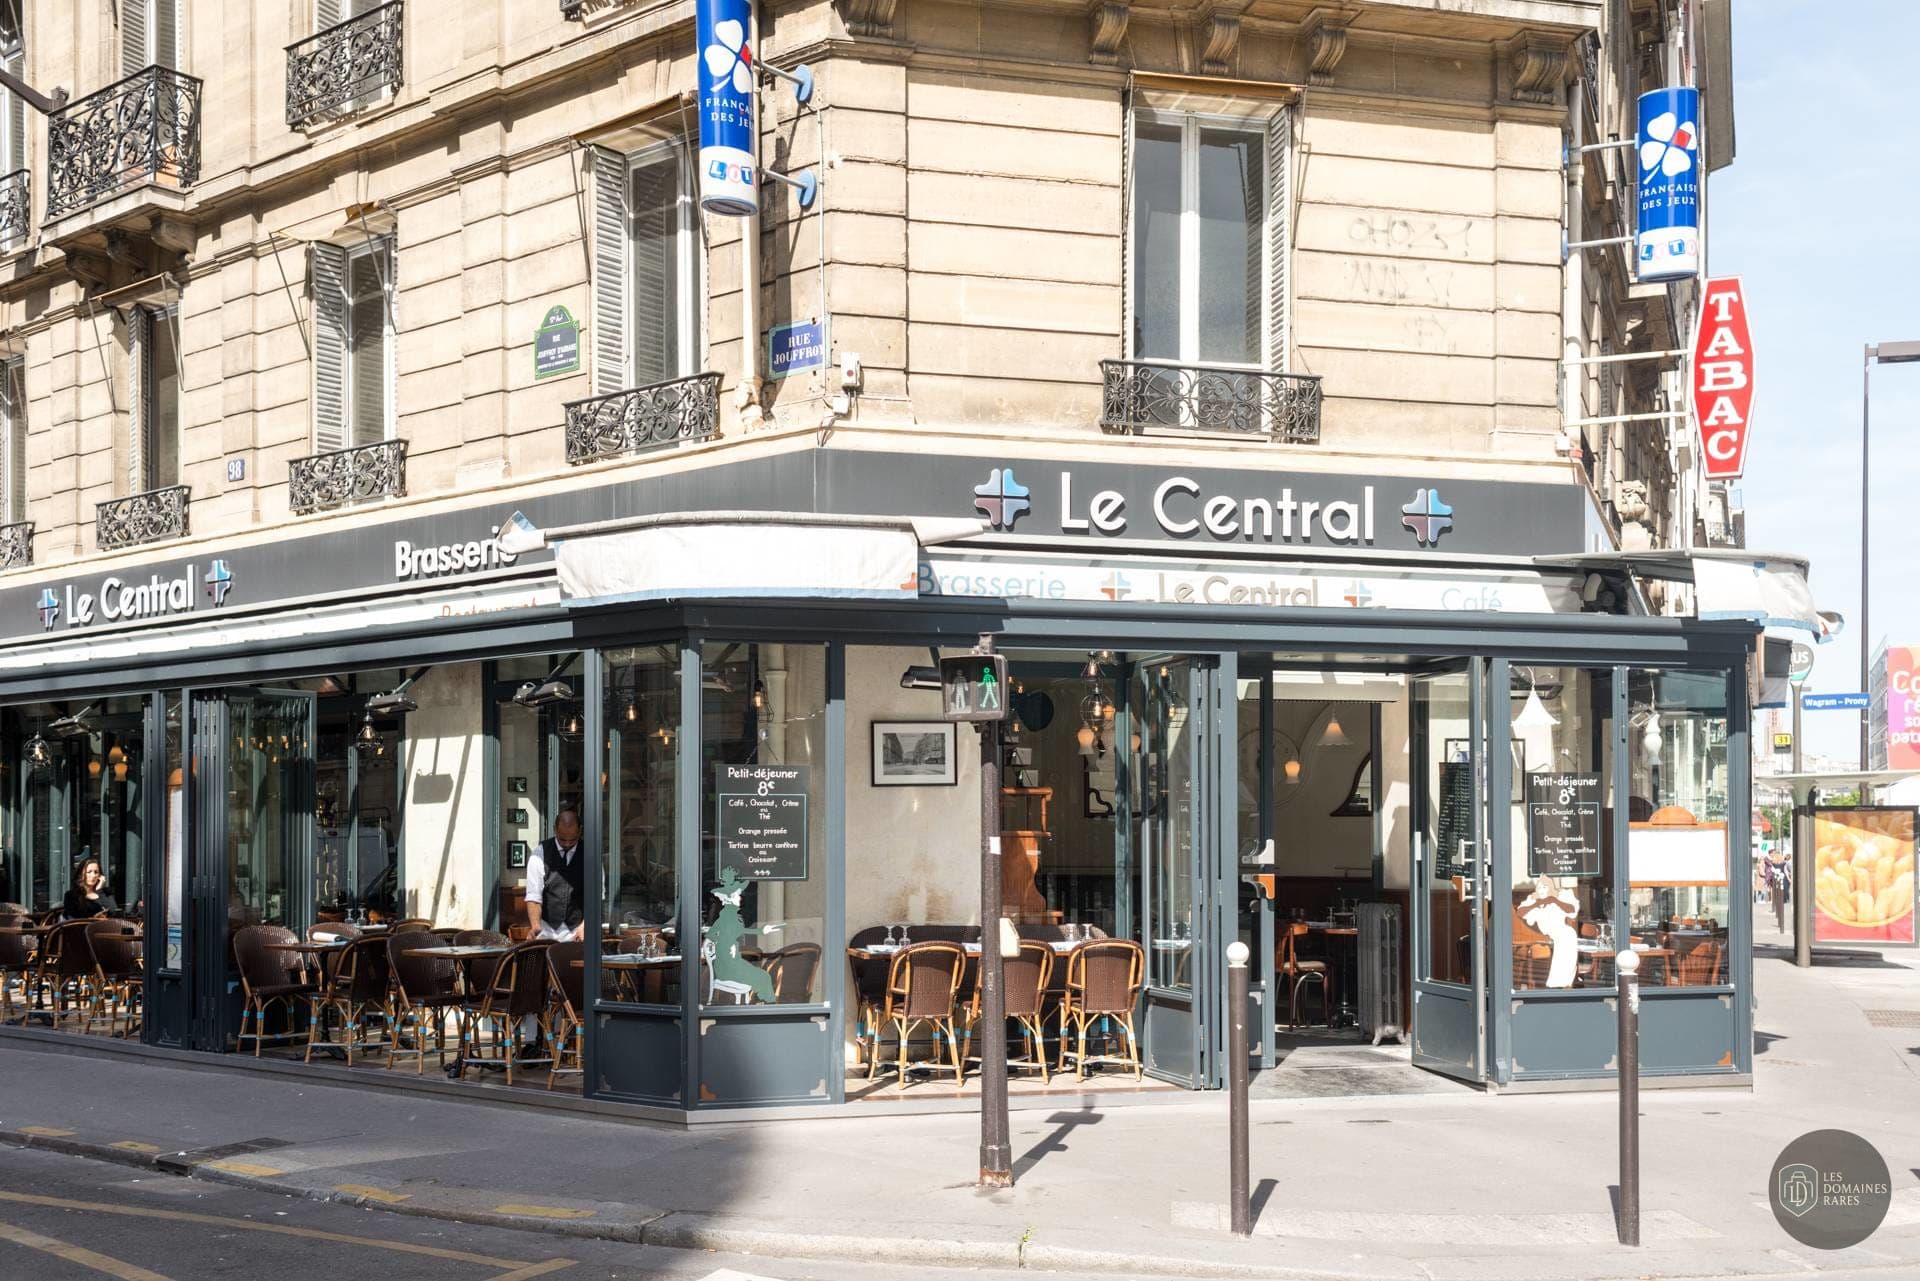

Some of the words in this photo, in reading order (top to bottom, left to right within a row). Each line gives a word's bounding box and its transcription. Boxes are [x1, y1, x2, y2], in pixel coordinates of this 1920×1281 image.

[711, 112, 734, 122] DES
[739, 116, 753, 129] JEU
[1643, 199, 1662, 210] DES
[1667, 196, 1695, 206] JEUX
[788, 333, 811, 348] RUE
[773, 344, 824, 365] JOUFFROY
[1700, 291, 1747, 461] TABAC
[229, 460, 242, 480] 98
[1061, 471, 1127, 532] Le
[1153, 476, 1375, 541] Central
[918, 562, 1066, 599] Brasserie
[1158, 573, 1195, 604] Le
[1203, 575, 1319, 607] Central
[1441, 587, 1503, 610] Café
[66, 584, 93, 624] Le
[100, 564, 194, 619] Central
[1805, 699, 1837, 707] Wagram
[1844, 697, 1868, 706] Prony
[727, 767, 798, 780] Petit-déjeuner
[757, 781, 776, 796] 8€
[1533, 775, 1598, 788] Petit-déjeuner
[738, 827, 761, 836] Orange
[728, 841, 749, 849] Tartine
[753, 841, 773, 849] beurre
